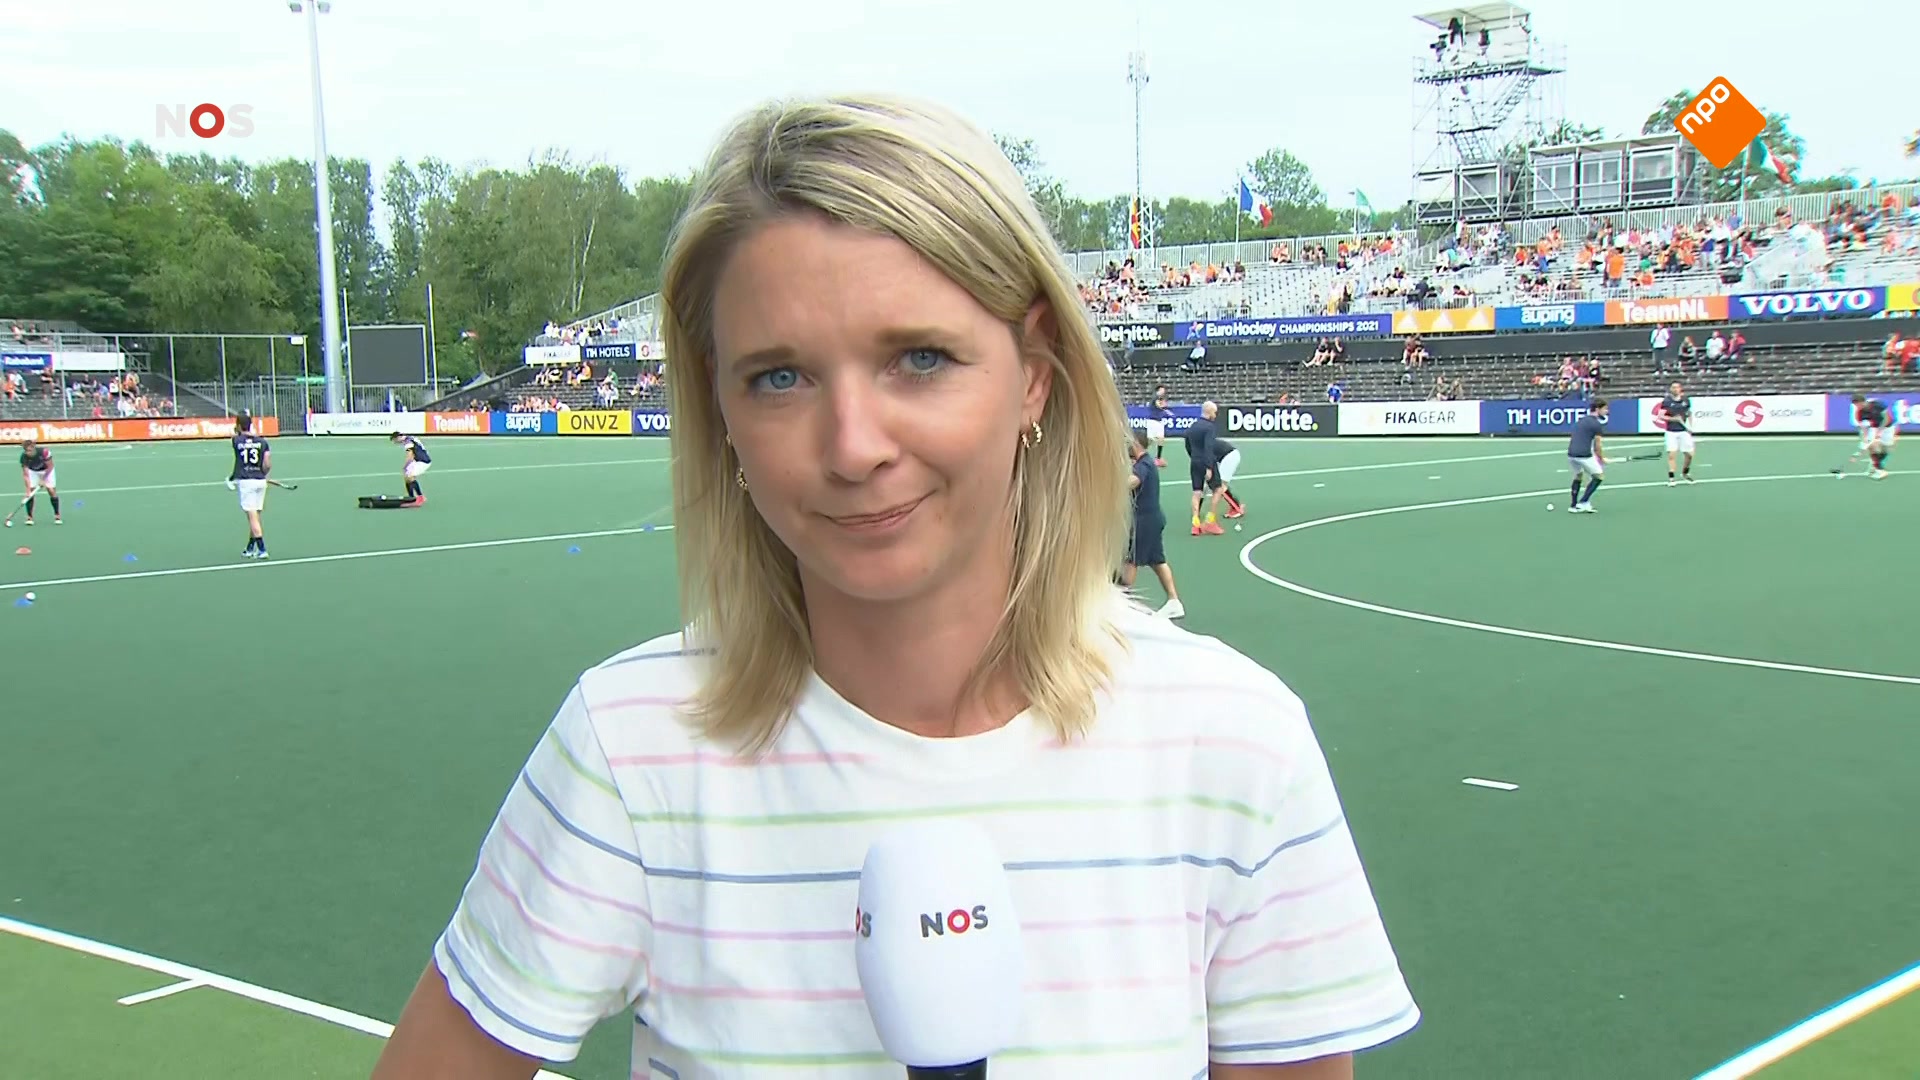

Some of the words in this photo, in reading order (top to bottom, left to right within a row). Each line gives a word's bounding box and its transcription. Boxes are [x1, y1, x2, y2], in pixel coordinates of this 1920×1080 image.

[1619, 299, 1709, 323] TeamNL
[1739, 289, 1875, 315] VOLVO
[1521, 305, 1575, 326] auping
[1279, 320, 1354, 335] CHAMPIONSHIPS
[1356, 320, 1379, 332] 2021
[599, 346, 631, 358] HOTELS
[433, 414, 481, 432] TeamNL
[505, 413, 542, 432] auping
[570, 414, 619, 431] ONVZ
[1228, 408, 1319, 431] Deloitte.
[1384, 410, 1456, 425] FIKAGEAR
[40, 423, 107, 440] TeamNL
[240, 448, 259, 464] 13
[920, 905, 989, 938] NOS
